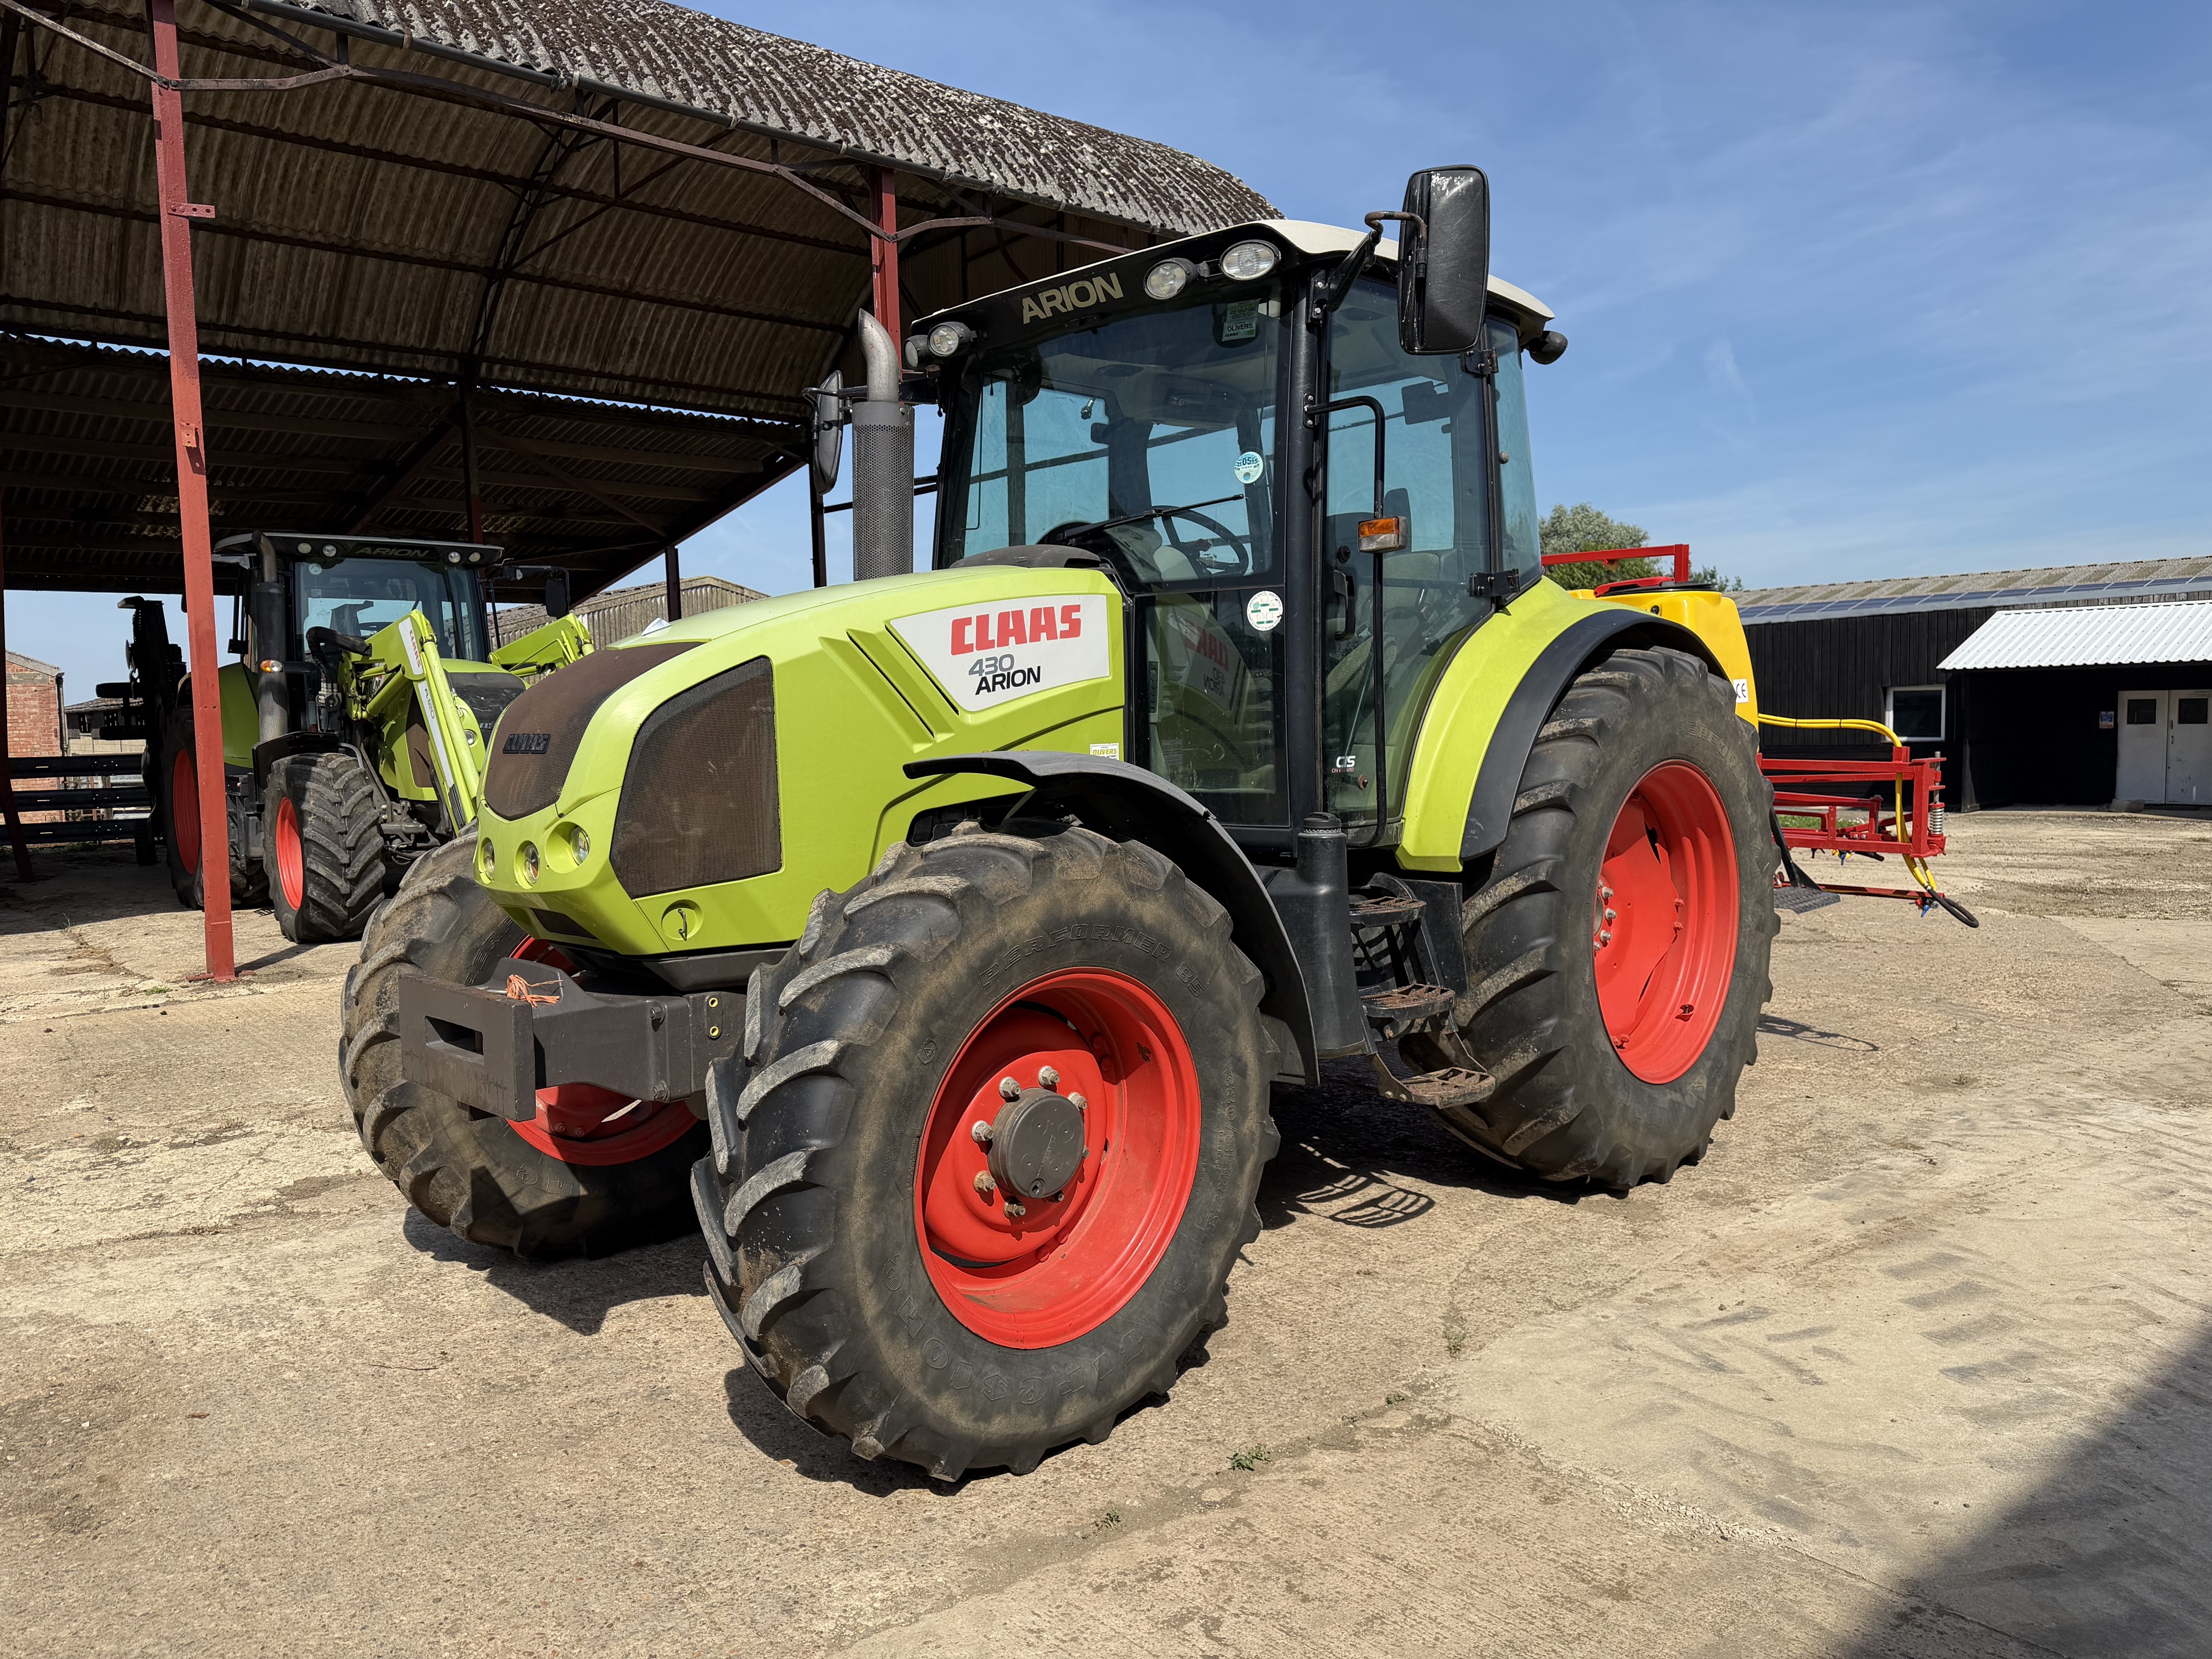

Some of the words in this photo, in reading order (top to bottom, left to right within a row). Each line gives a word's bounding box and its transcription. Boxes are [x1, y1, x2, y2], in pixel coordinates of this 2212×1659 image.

[1022, 272, 1124, 325] ARION
[1227, 323, 1253, 332] OLIVERS
[354, 547, 429, 557] ARION
[951, 604, 1082, 656] CLAAS
[409, 629, 421, 668] CLAAS
[968, 653, 1015, 677] 430
[974, 665, 1041, 696] ARION
[1736, 683, 1746, 698] CE
[503, 734, 551, 754] CLAAS
[979, 924, 1172, 988] PERFORMER
[1175, 962, 1206, 998] 85
[1205, 1068, 1237, 1233] 380/85R28
